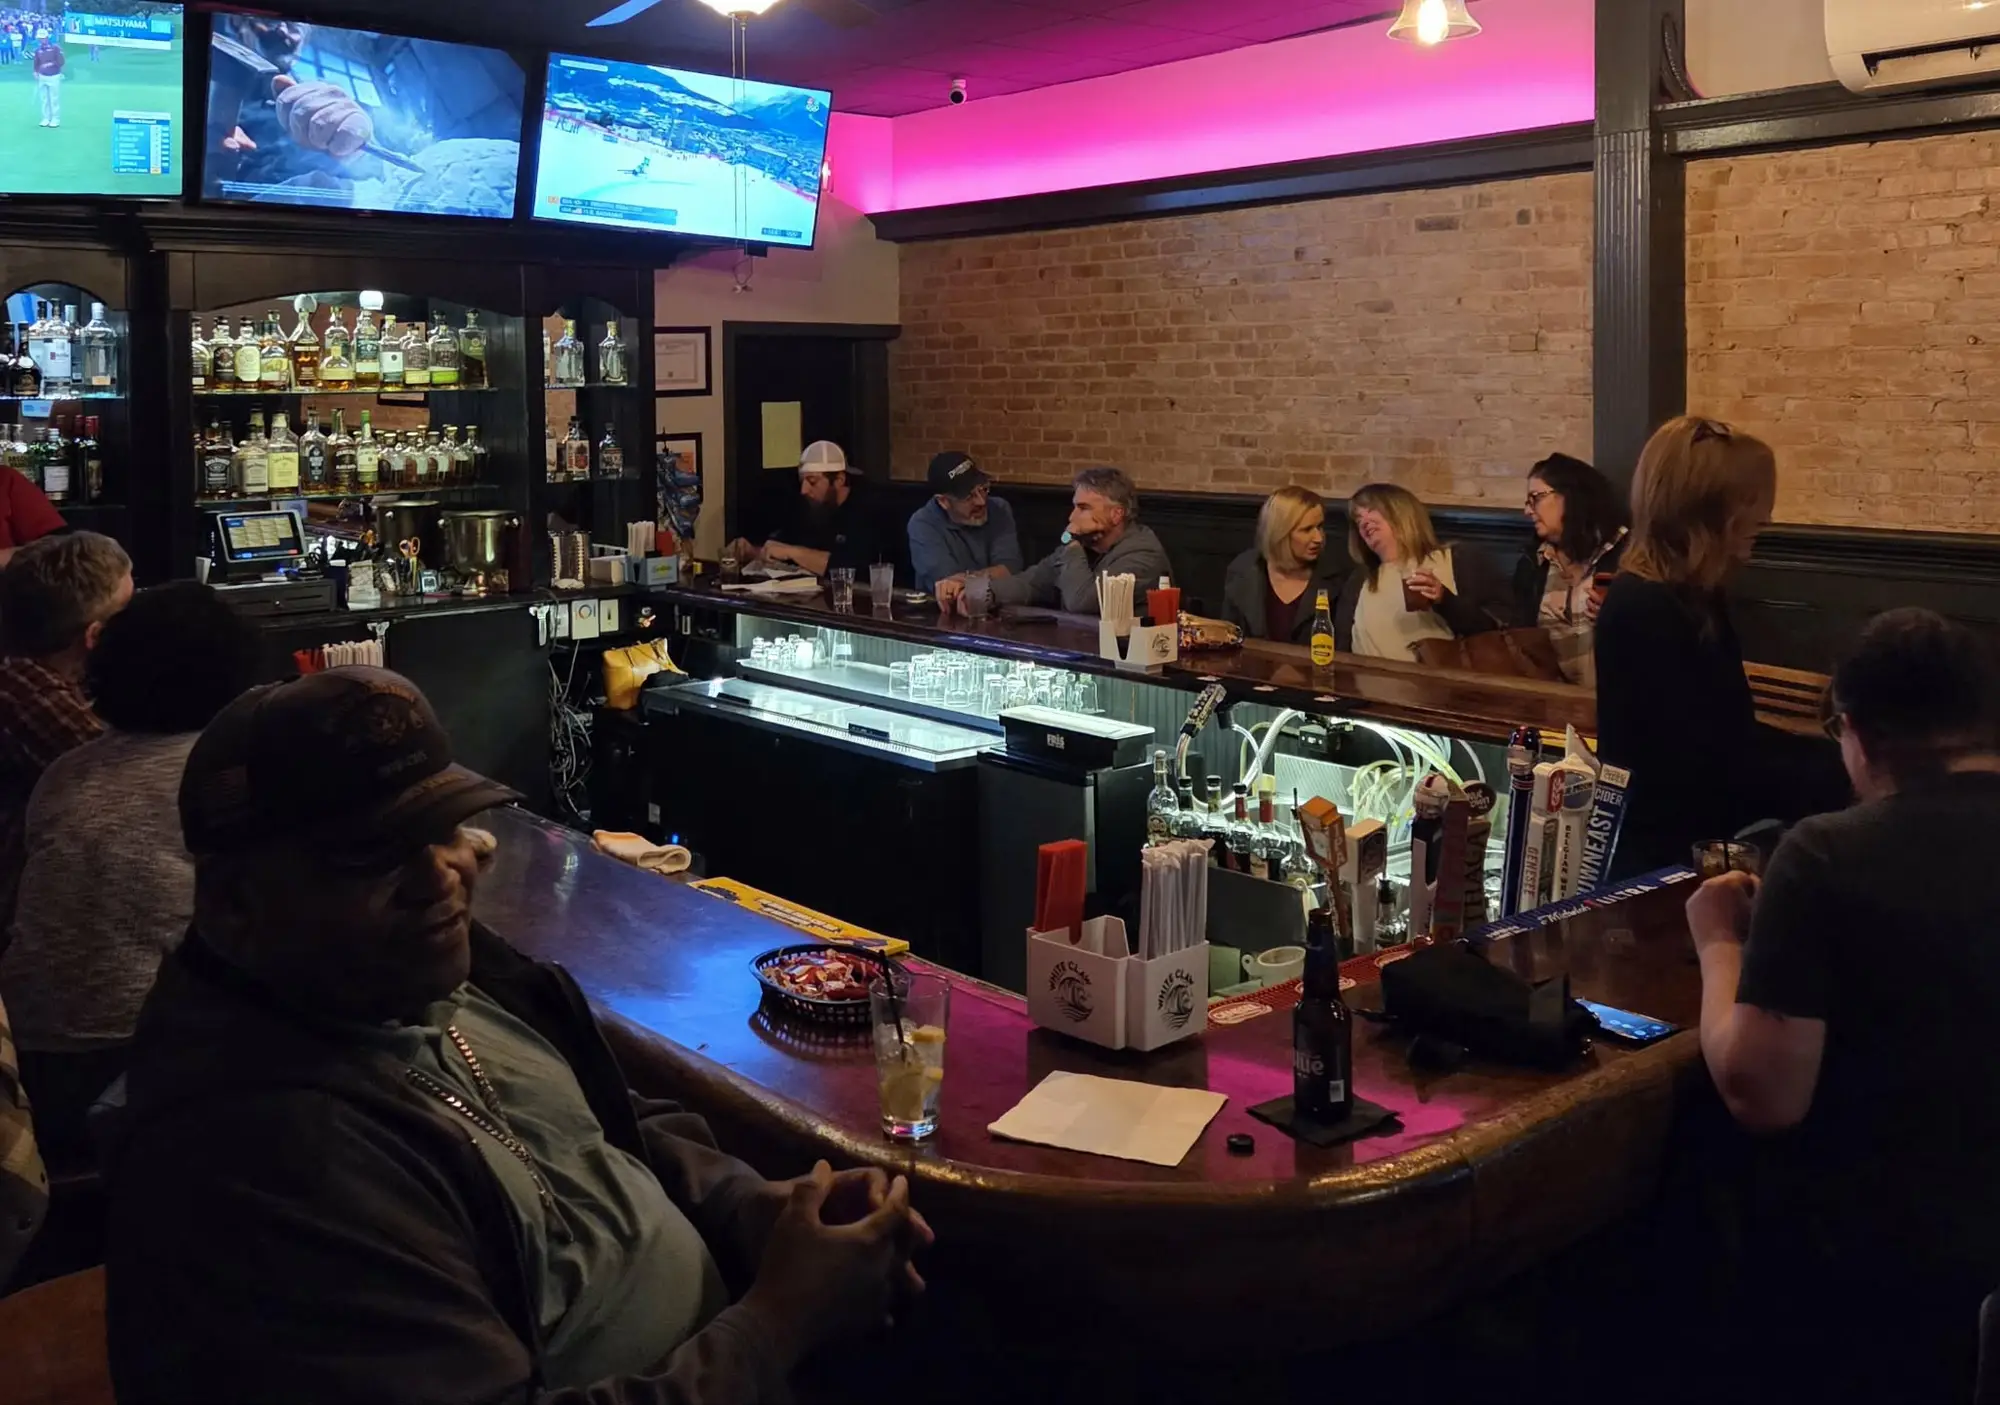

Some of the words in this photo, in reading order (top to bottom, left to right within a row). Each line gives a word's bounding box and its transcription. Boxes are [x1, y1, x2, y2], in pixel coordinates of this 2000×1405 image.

[94, 17, 148, 29] MATSUYAMA
[1594, 788, 1623, 807] CIDER
[1561, 825, 1571, 875] BELGIAN
[1576, 805, 1615, 897] OWNEAST
[1524, 847, 1539, 898] GENESEE
[1539, 902, 1591, 925] Michelob
[1596, 884, 1659, 905] ULTRA
[1049, 961, 1067, 990] WHITE
[1068, 960, 1092, 985] CLAW
[1158, 973, 1173, 1010] WHITE
[1175, 968, 1194, 985] CLAW
[1296, 1051, 1324, 1076] lue
